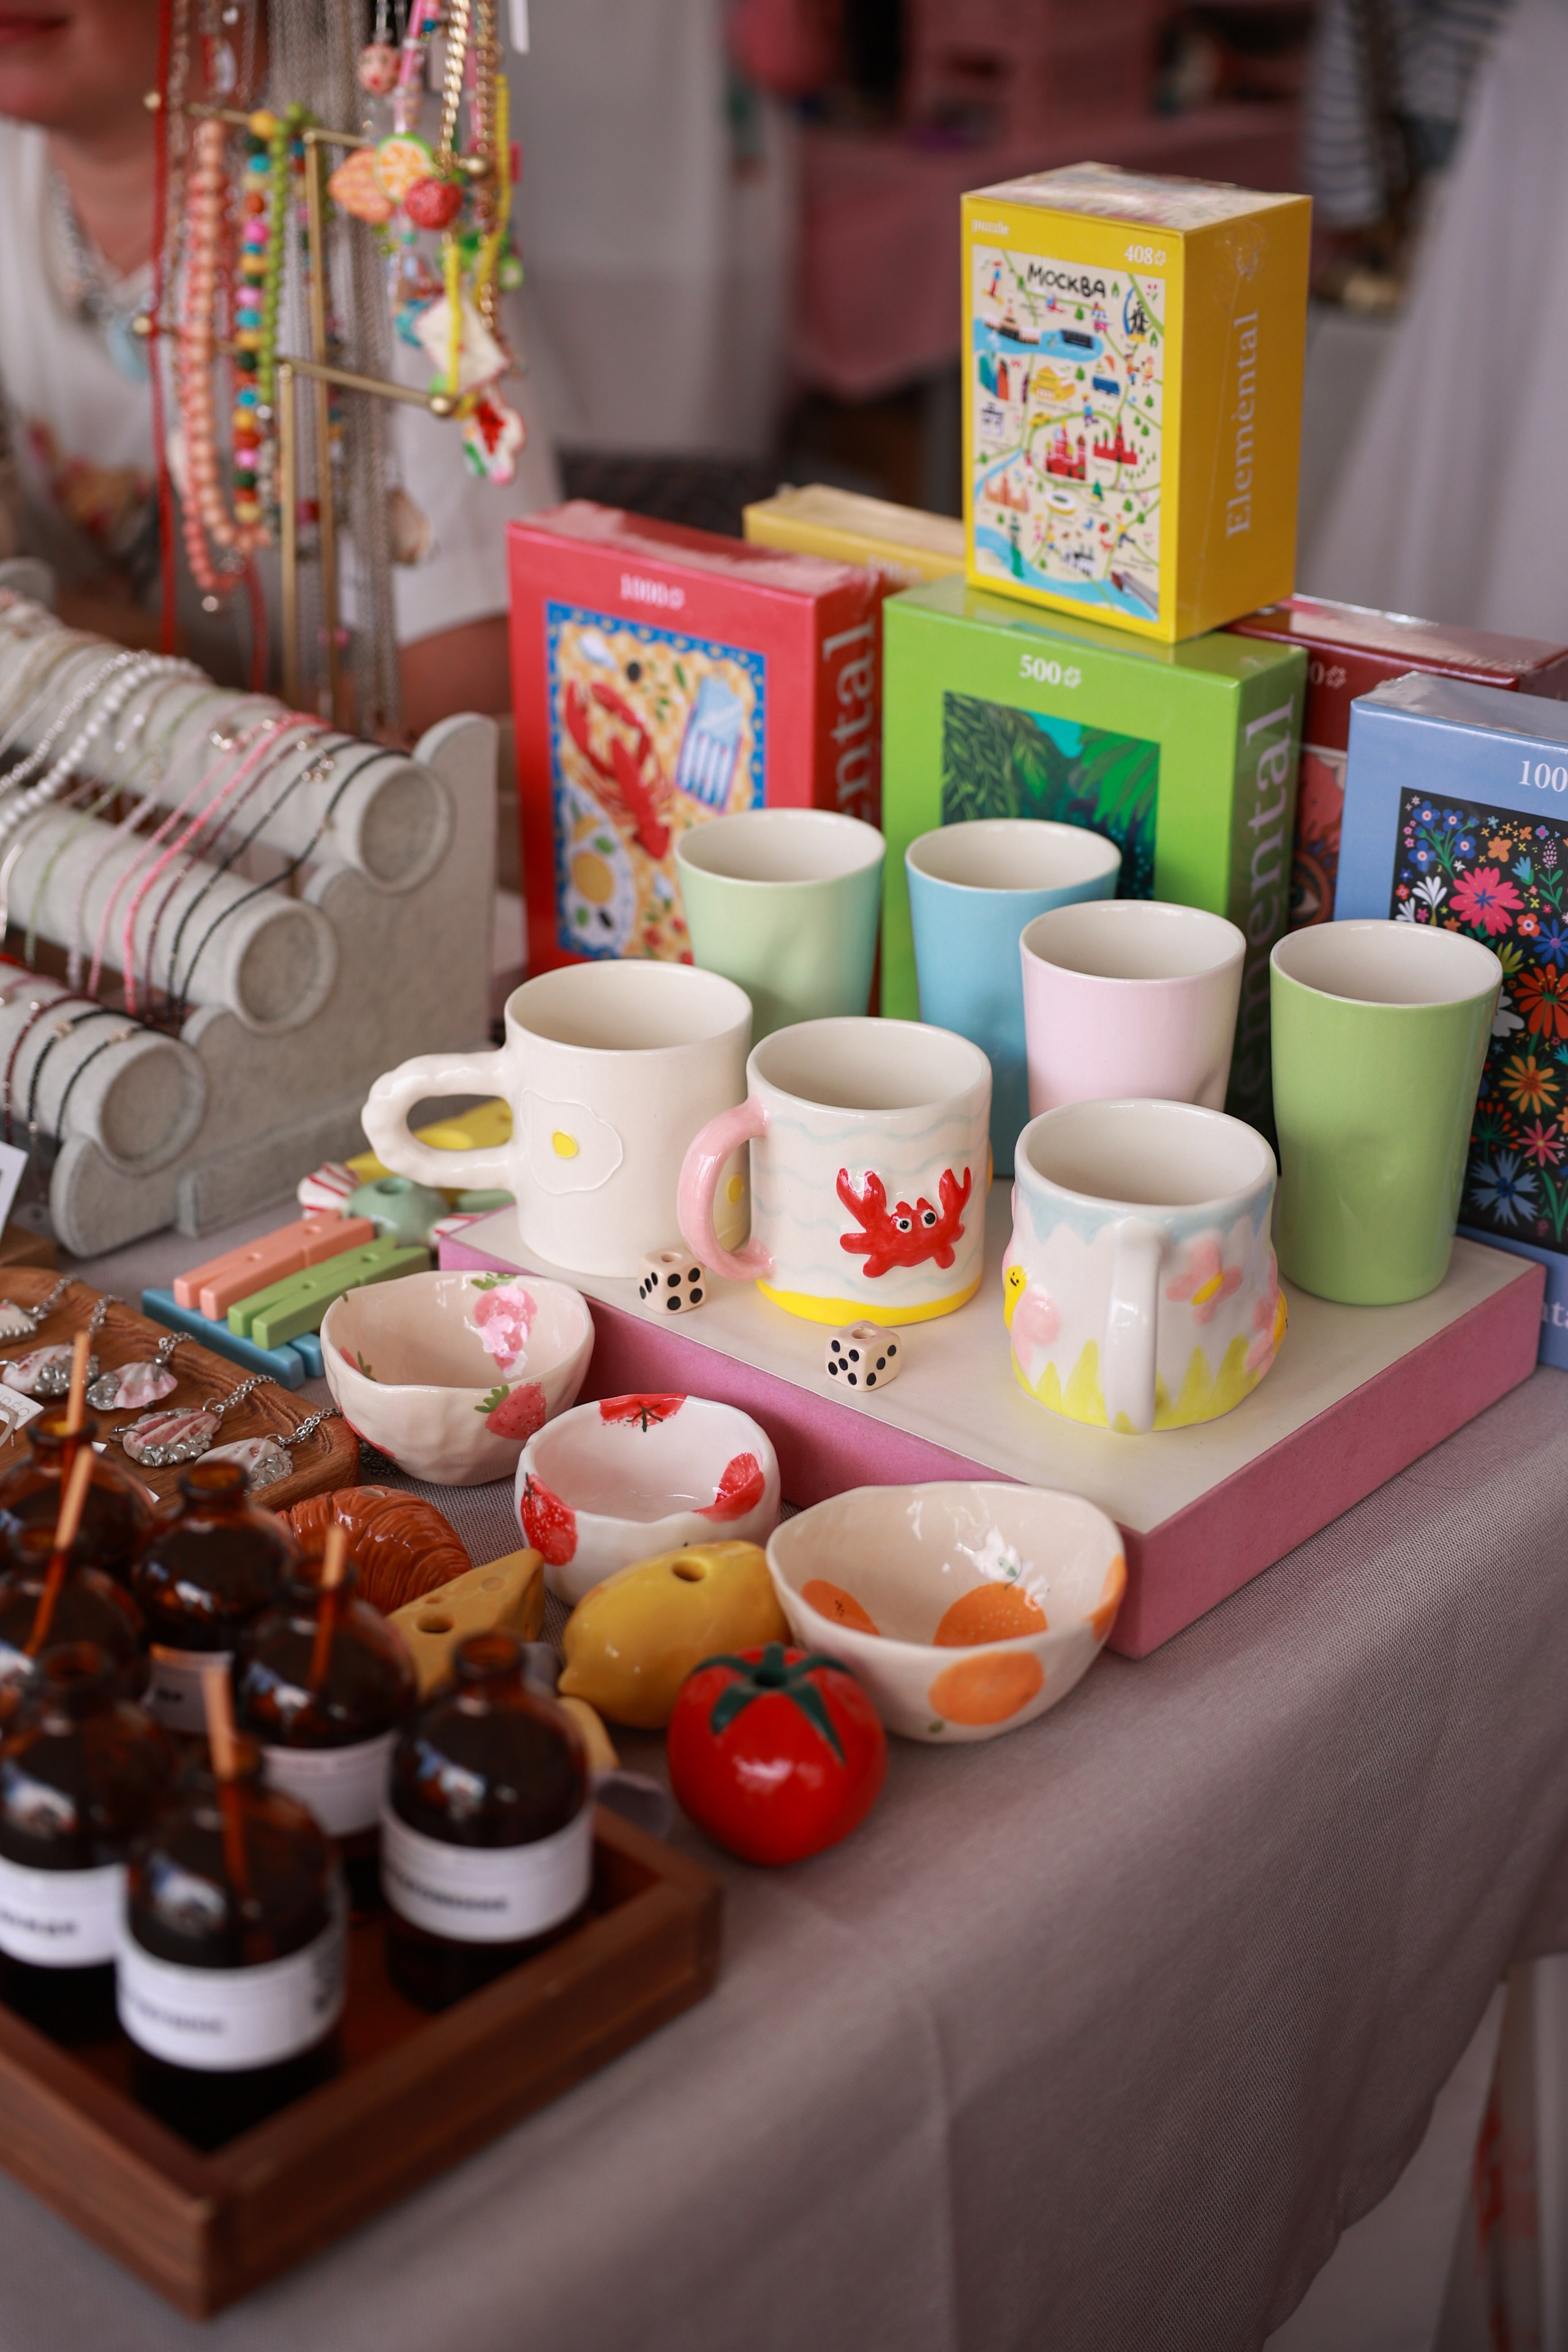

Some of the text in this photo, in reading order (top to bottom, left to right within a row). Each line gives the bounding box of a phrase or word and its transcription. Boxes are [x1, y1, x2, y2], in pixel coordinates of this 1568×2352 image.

[1124, 243, 1153, 266] 408
[1027, 262, 1106, 298] МОСКВА
[1019, 654, 1061, 685] 500
[822, 614, 875, 818] ntal
